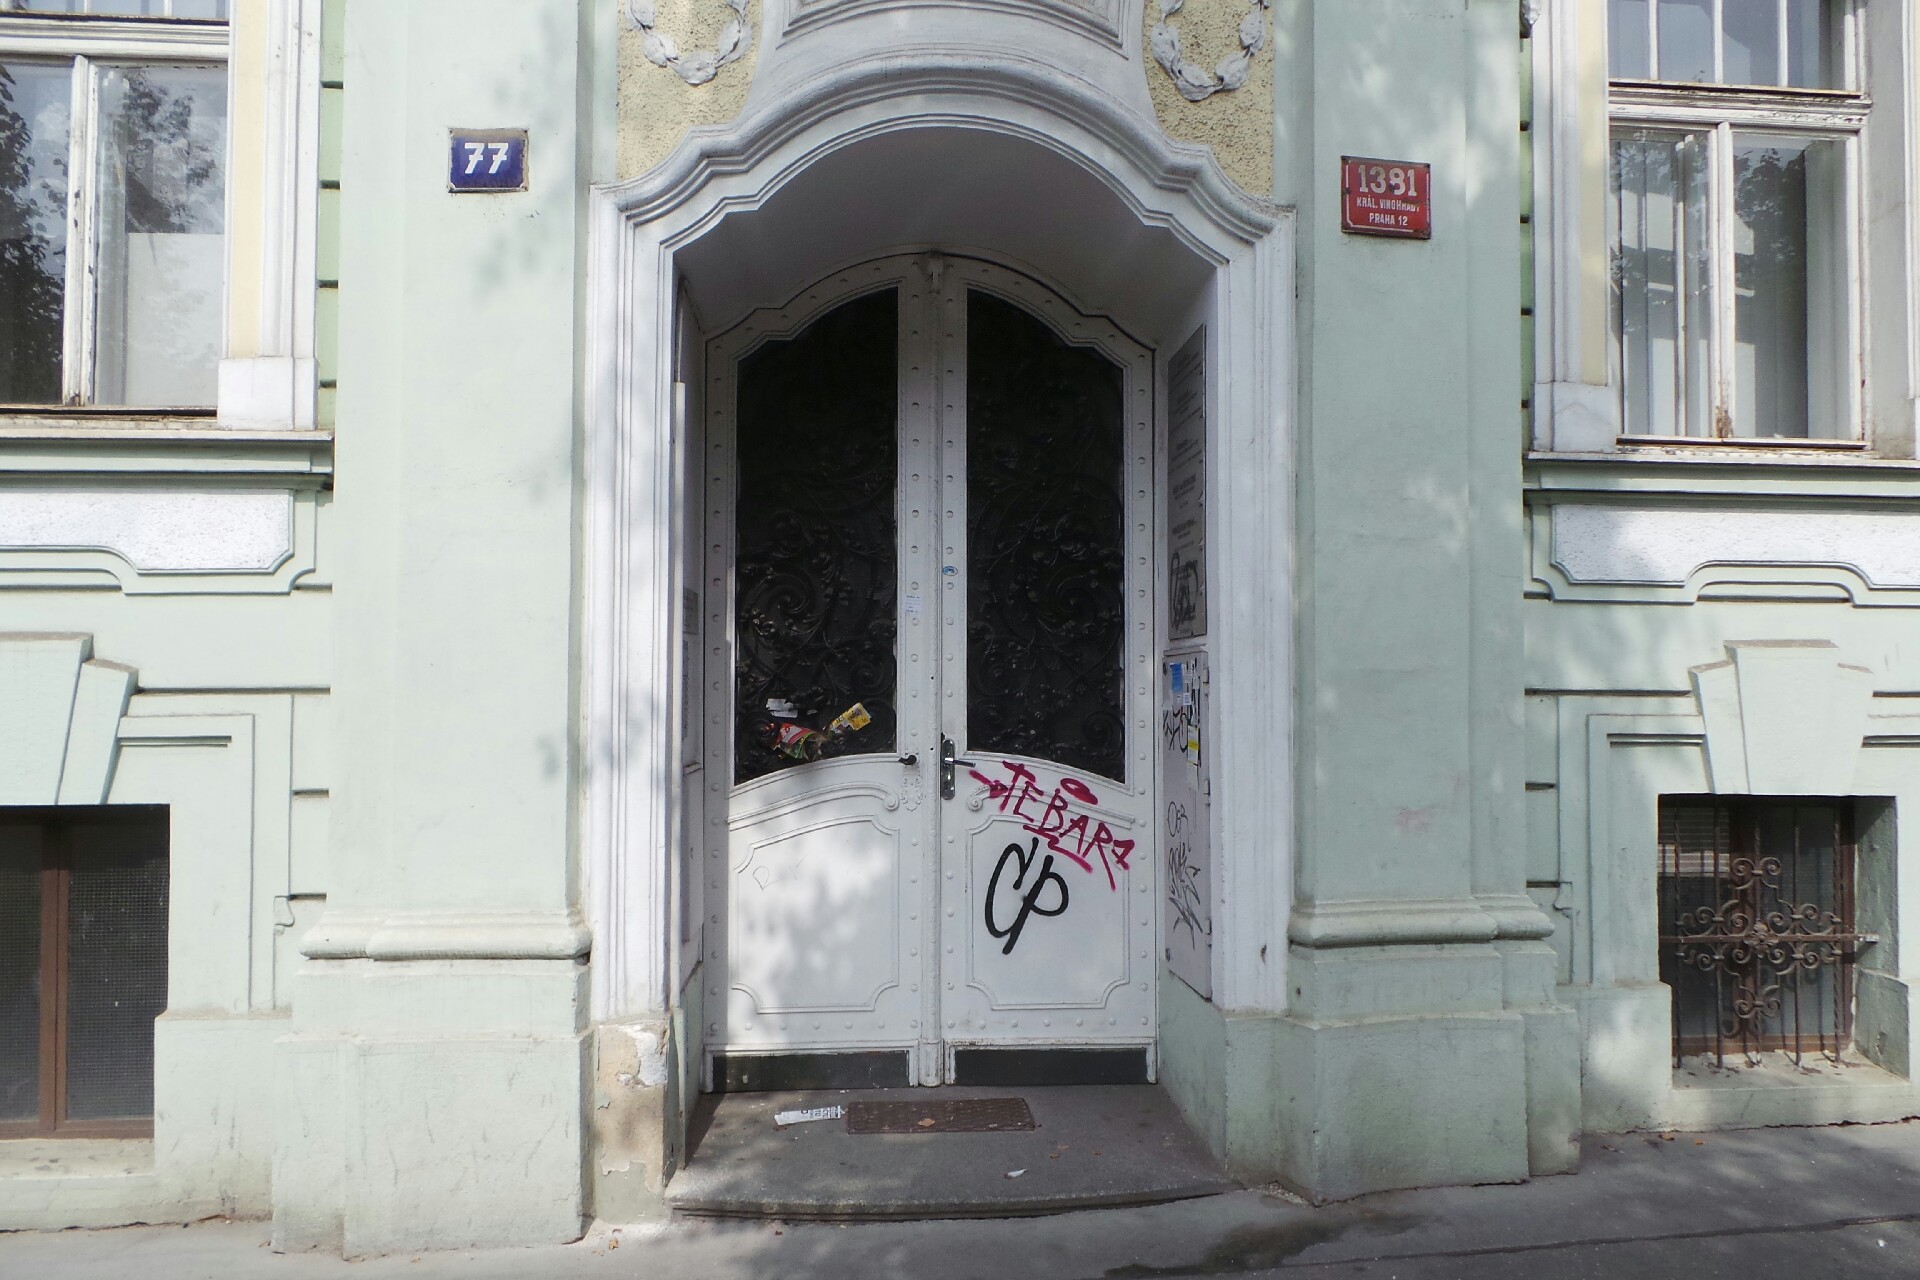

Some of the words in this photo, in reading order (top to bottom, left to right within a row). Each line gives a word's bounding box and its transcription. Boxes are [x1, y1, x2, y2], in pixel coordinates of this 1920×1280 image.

[464, 142, 509, 174] 77
[1358, 164, 1417, 197] 1381
[1356, 194, 1378, 209] KRÁL.
[1369, 212, 1396, 225] PRAHA
[1398, 215, 1408, 226] 12
